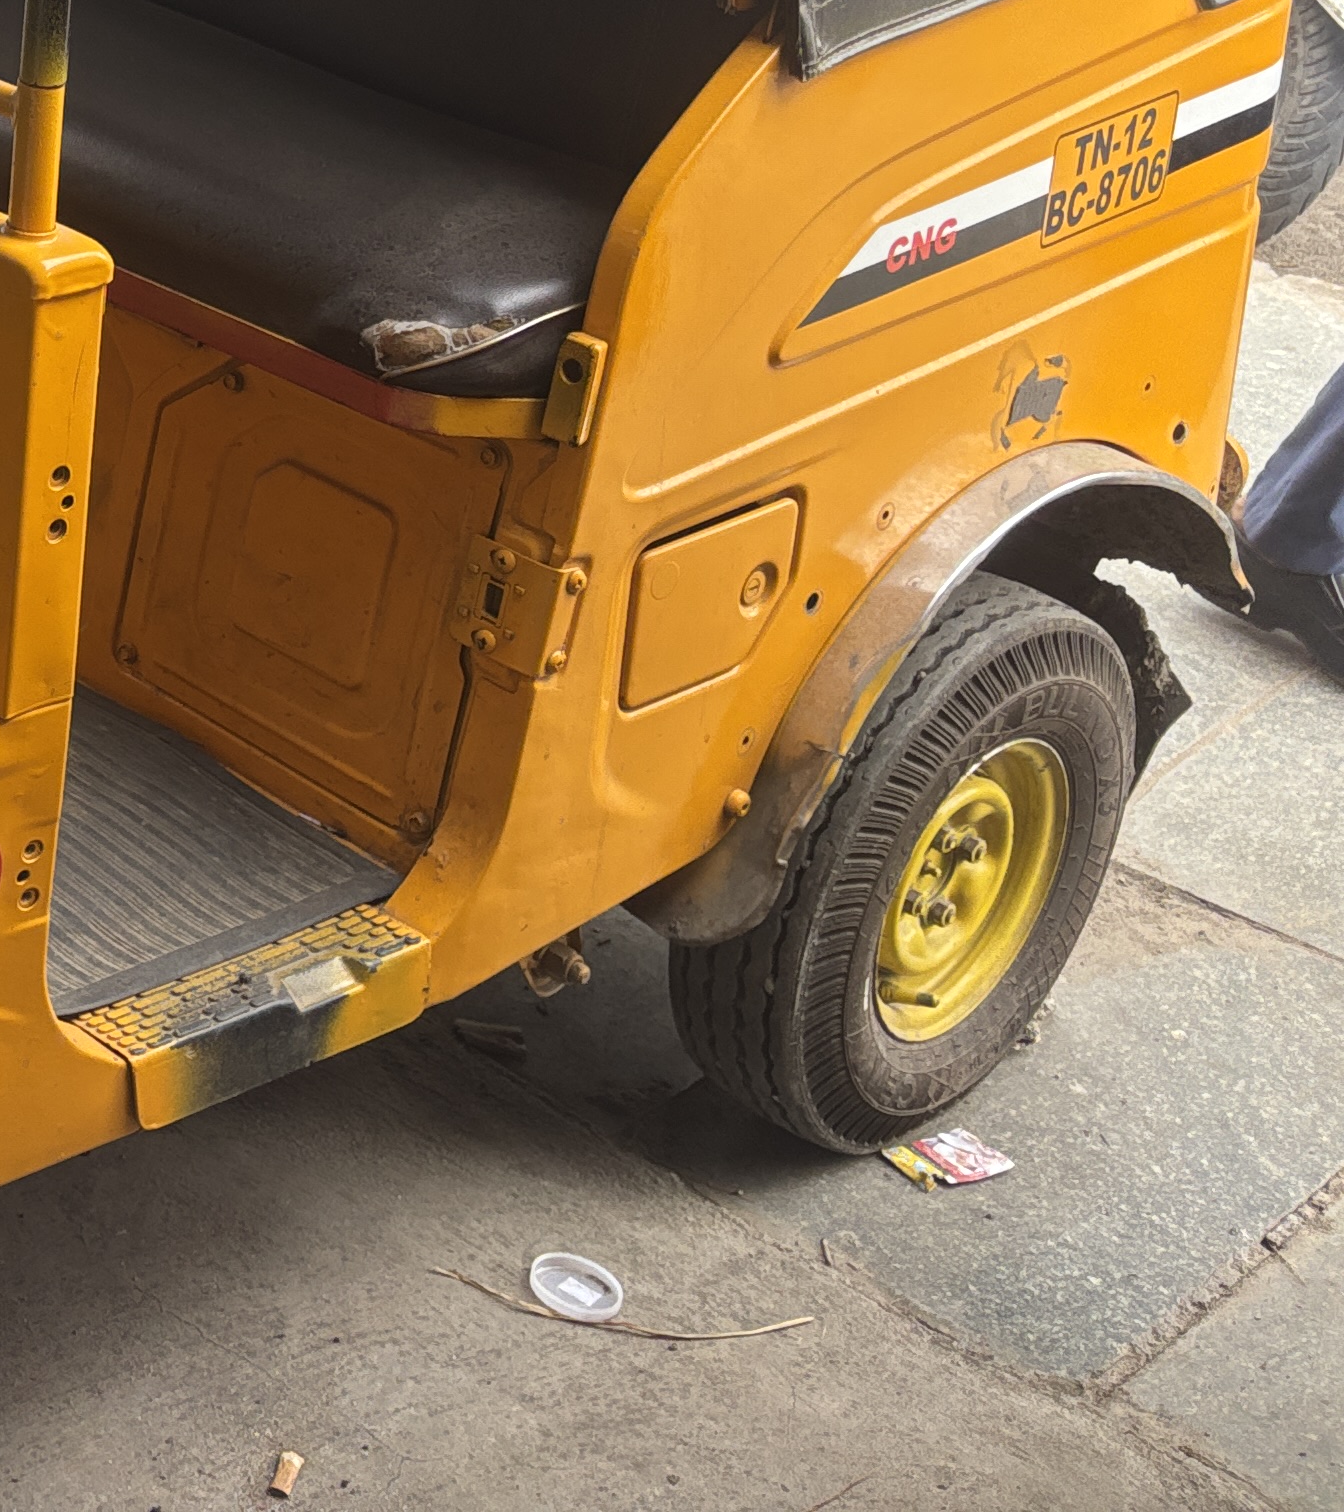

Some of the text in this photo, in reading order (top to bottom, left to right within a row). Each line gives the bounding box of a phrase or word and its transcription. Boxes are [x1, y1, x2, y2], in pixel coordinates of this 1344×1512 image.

[1074, 107, 1158, 176] TN-12
[1045, 149, 1167, 238] BC-8706
[885, 217, 958, 274] CNG
